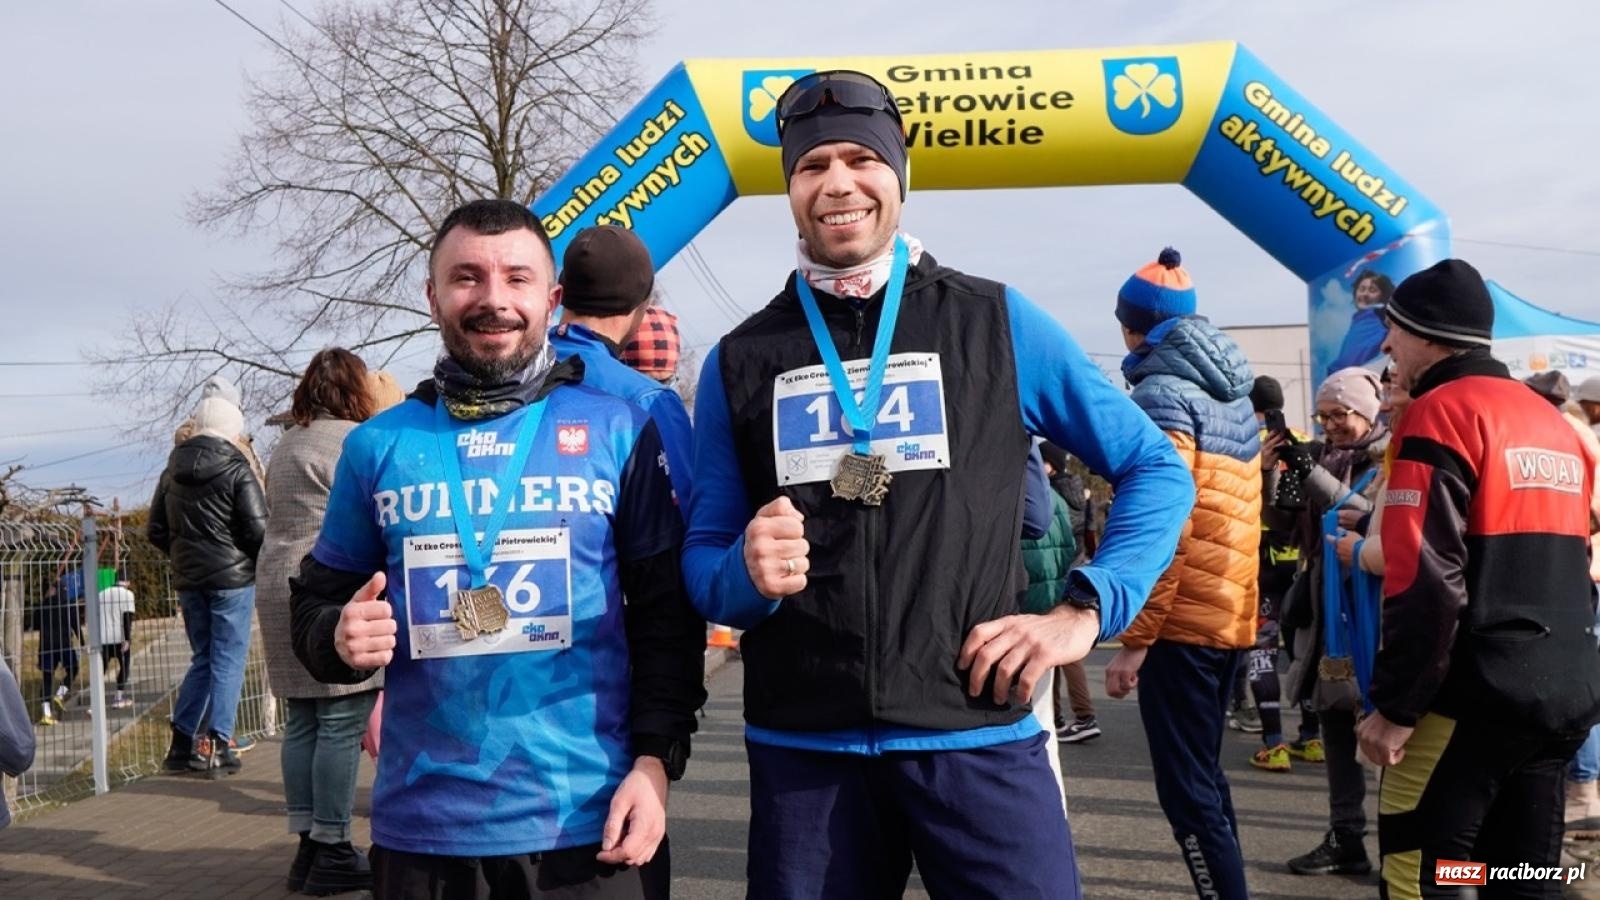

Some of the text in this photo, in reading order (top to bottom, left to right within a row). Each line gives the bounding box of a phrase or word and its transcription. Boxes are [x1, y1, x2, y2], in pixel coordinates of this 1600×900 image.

[887, 63, 1032, 83] Gmina
[897, 85, 1074, 115] etrowice
[541, 99, 687, 239] Gmina ludzi
[595, 132, 711, 230] tywnych
[1218, 113, 1376, 246] aktywnych
[1243, 80, 1408, 218] Gmina ludzi
[424, 543, 438, 551] Eko
[435, 563, 541, 620] 16
